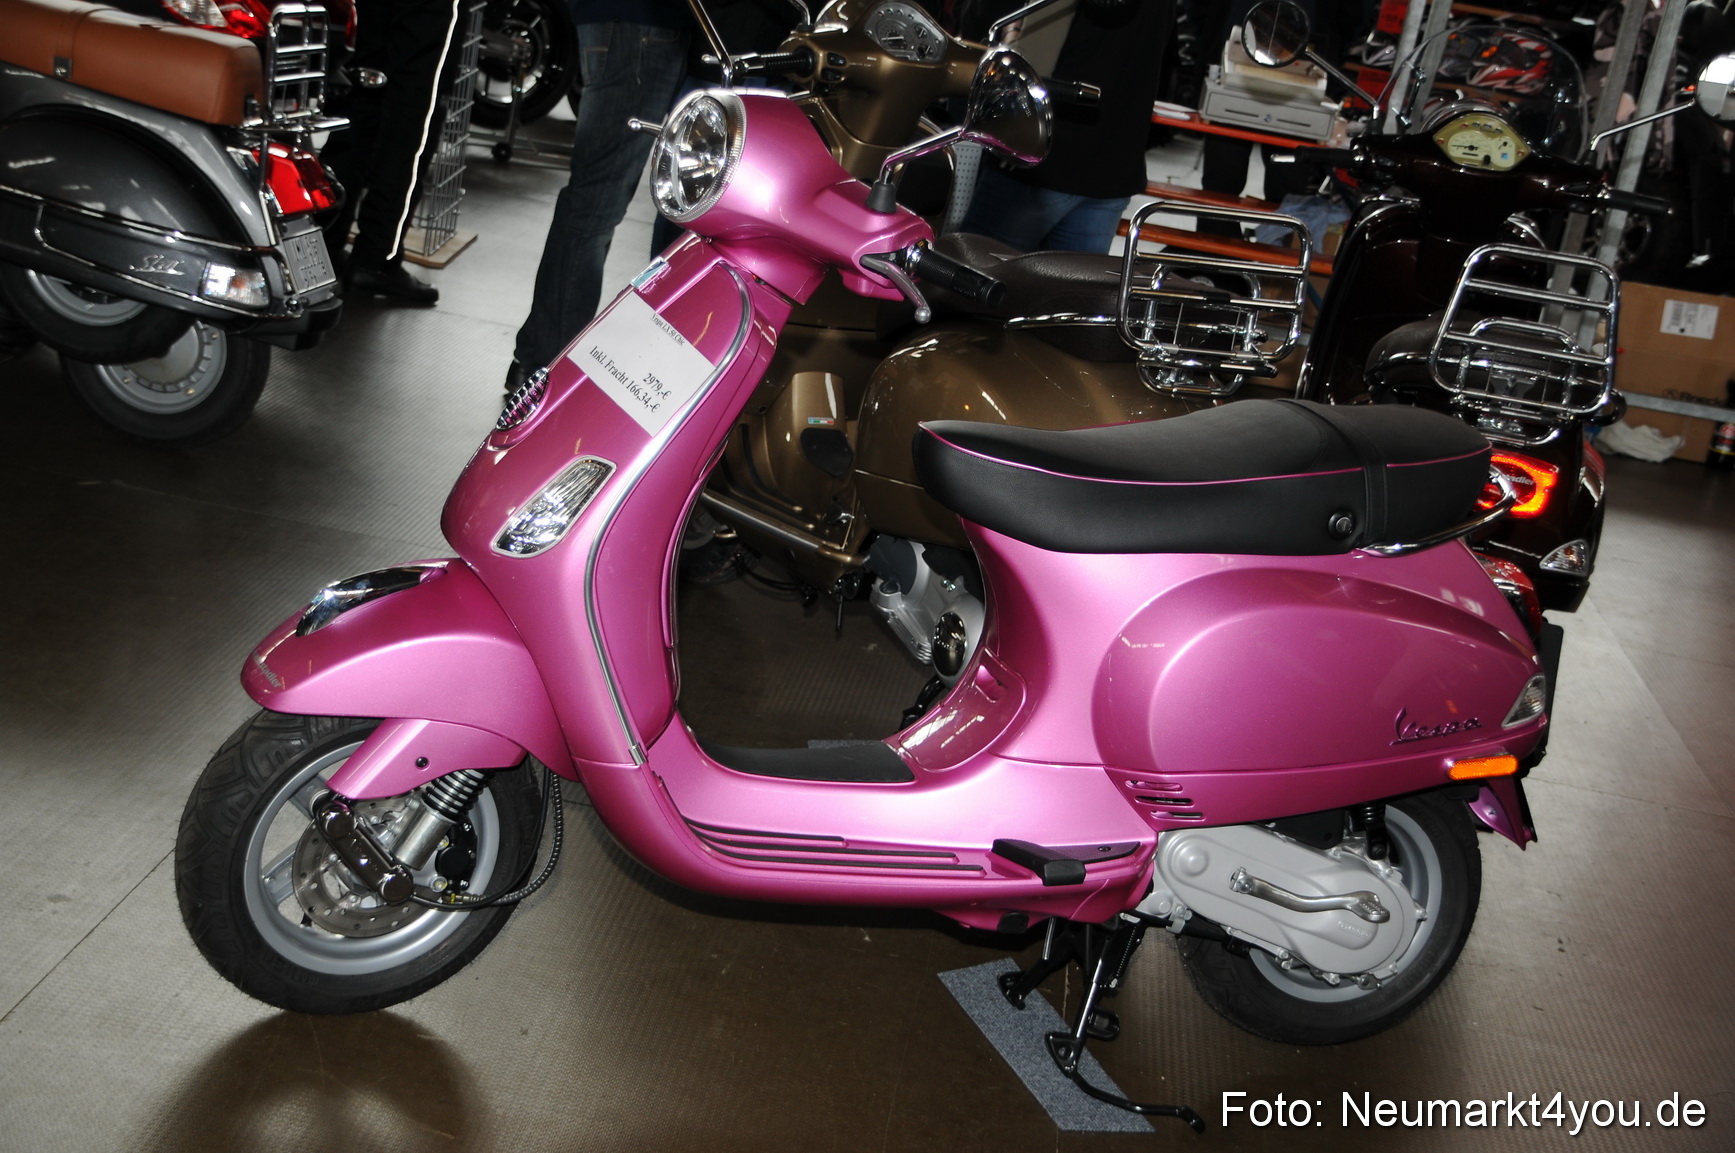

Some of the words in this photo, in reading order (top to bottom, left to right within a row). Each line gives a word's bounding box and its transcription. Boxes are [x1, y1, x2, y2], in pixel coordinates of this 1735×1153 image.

[589, 346, 607, 365] Inkl.
[604, 360, 629, 385] Fracht
[626, 380, 660, 413] 166,34,-€
[643, 373, 672, 400] 2979,-€
[1389, 707, 1482, 746] Vespa
